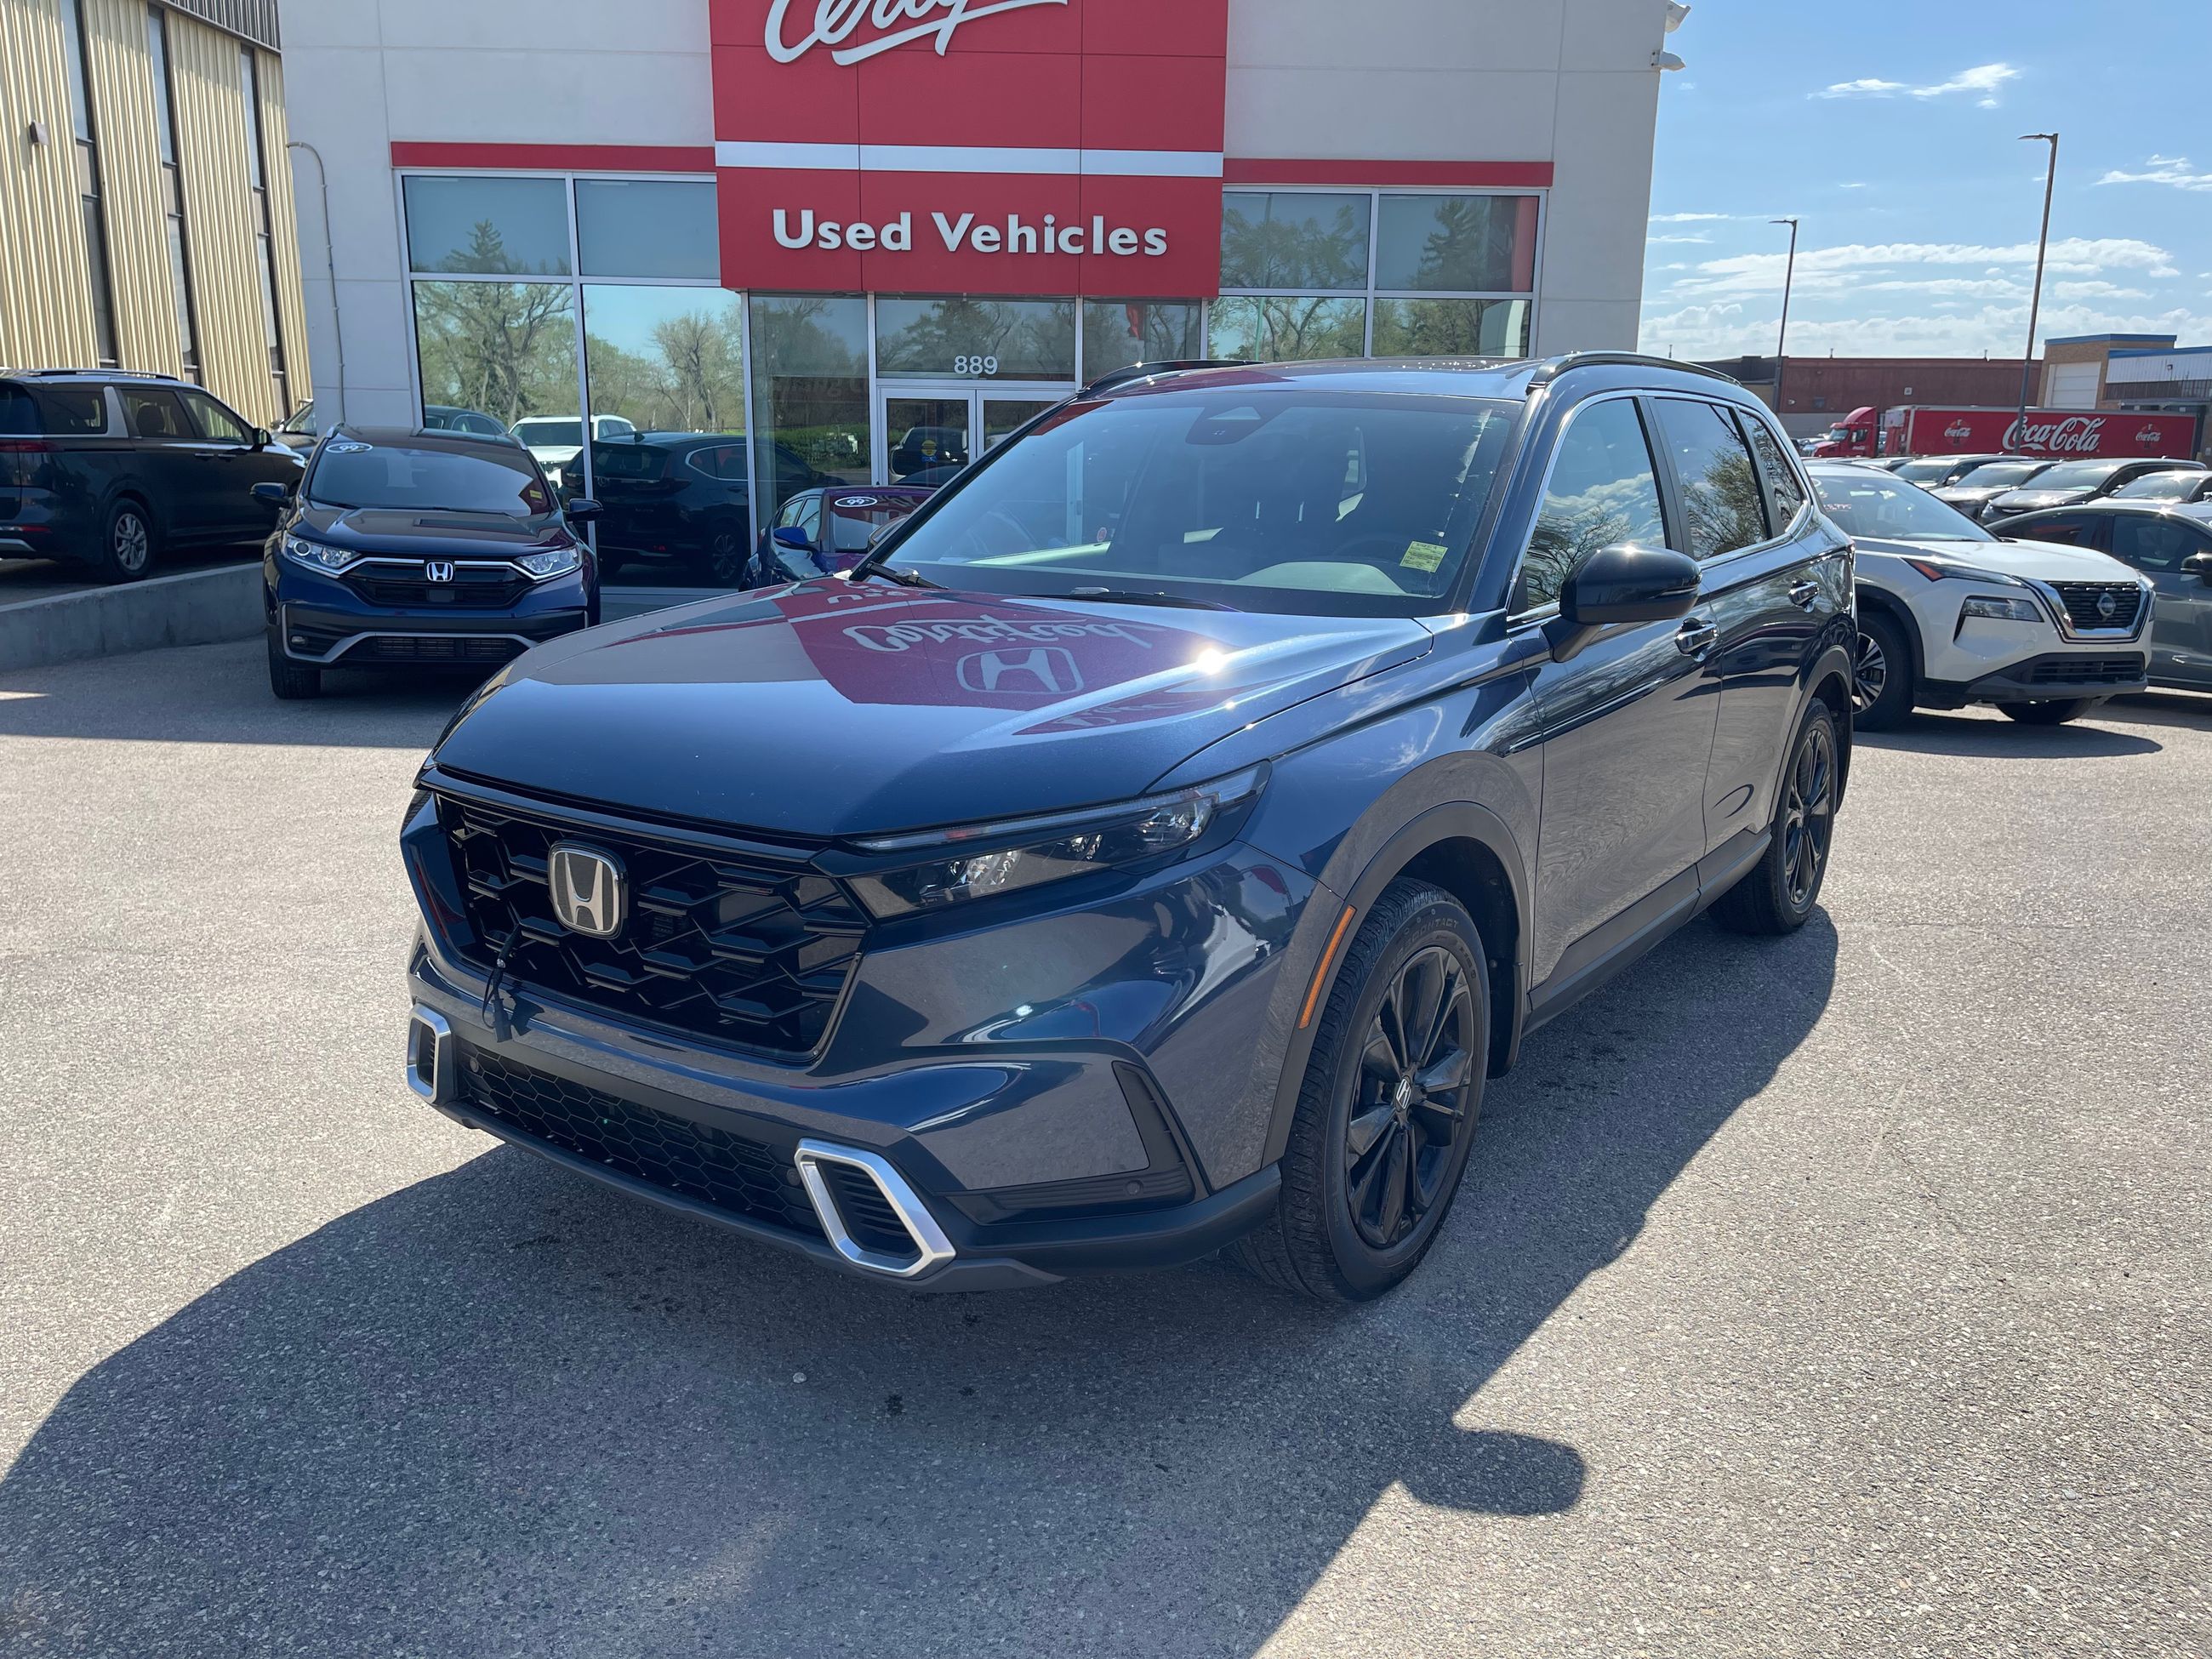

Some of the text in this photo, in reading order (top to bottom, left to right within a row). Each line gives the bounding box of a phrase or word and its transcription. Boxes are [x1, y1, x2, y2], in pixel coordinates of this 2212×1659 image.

[772, 208, 1167, 256] Used Vehicles
[954, 355, 998, 374] 889
[2002, 416, 2107, 452] Coca-Cola
